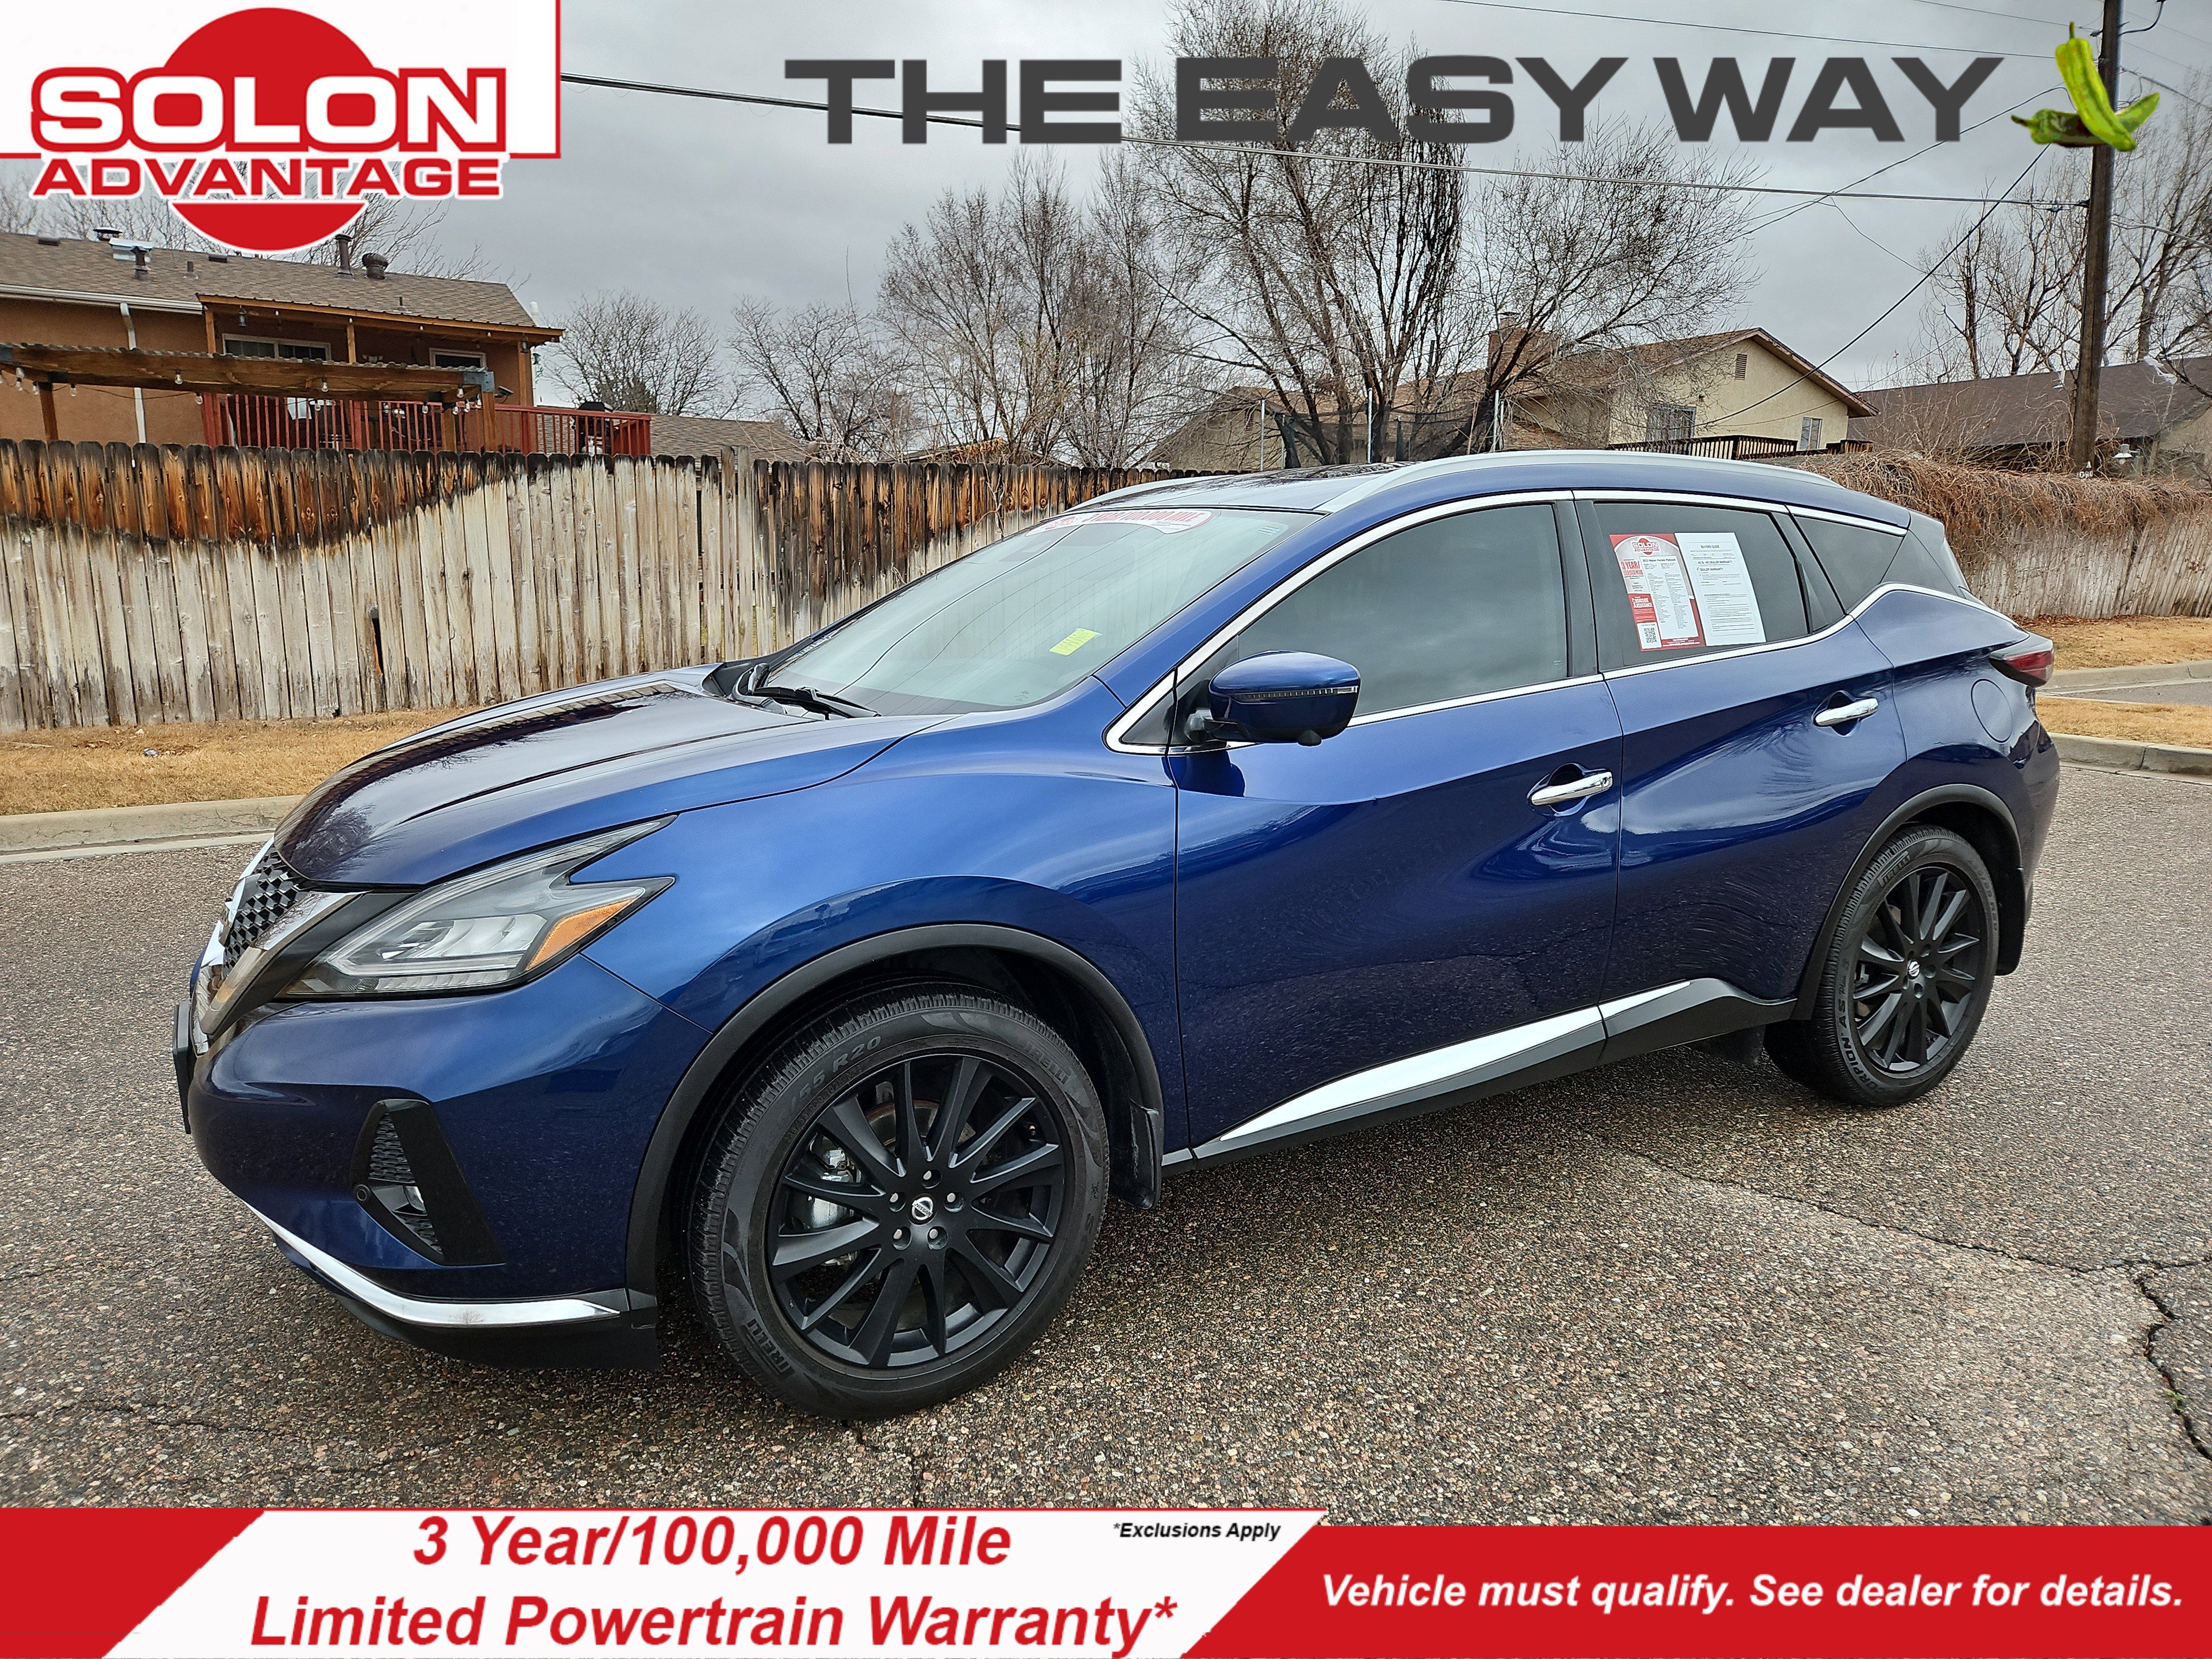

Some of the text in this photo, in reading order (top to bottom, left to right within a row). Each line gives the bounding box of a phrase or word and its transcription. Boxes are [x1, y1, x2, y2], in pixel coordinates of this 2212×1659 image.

[1621, 561, 1625, 569] 3
[833, 1036, 882, 1073] R20
[914, 1203, 933, 1216] NISSAN
